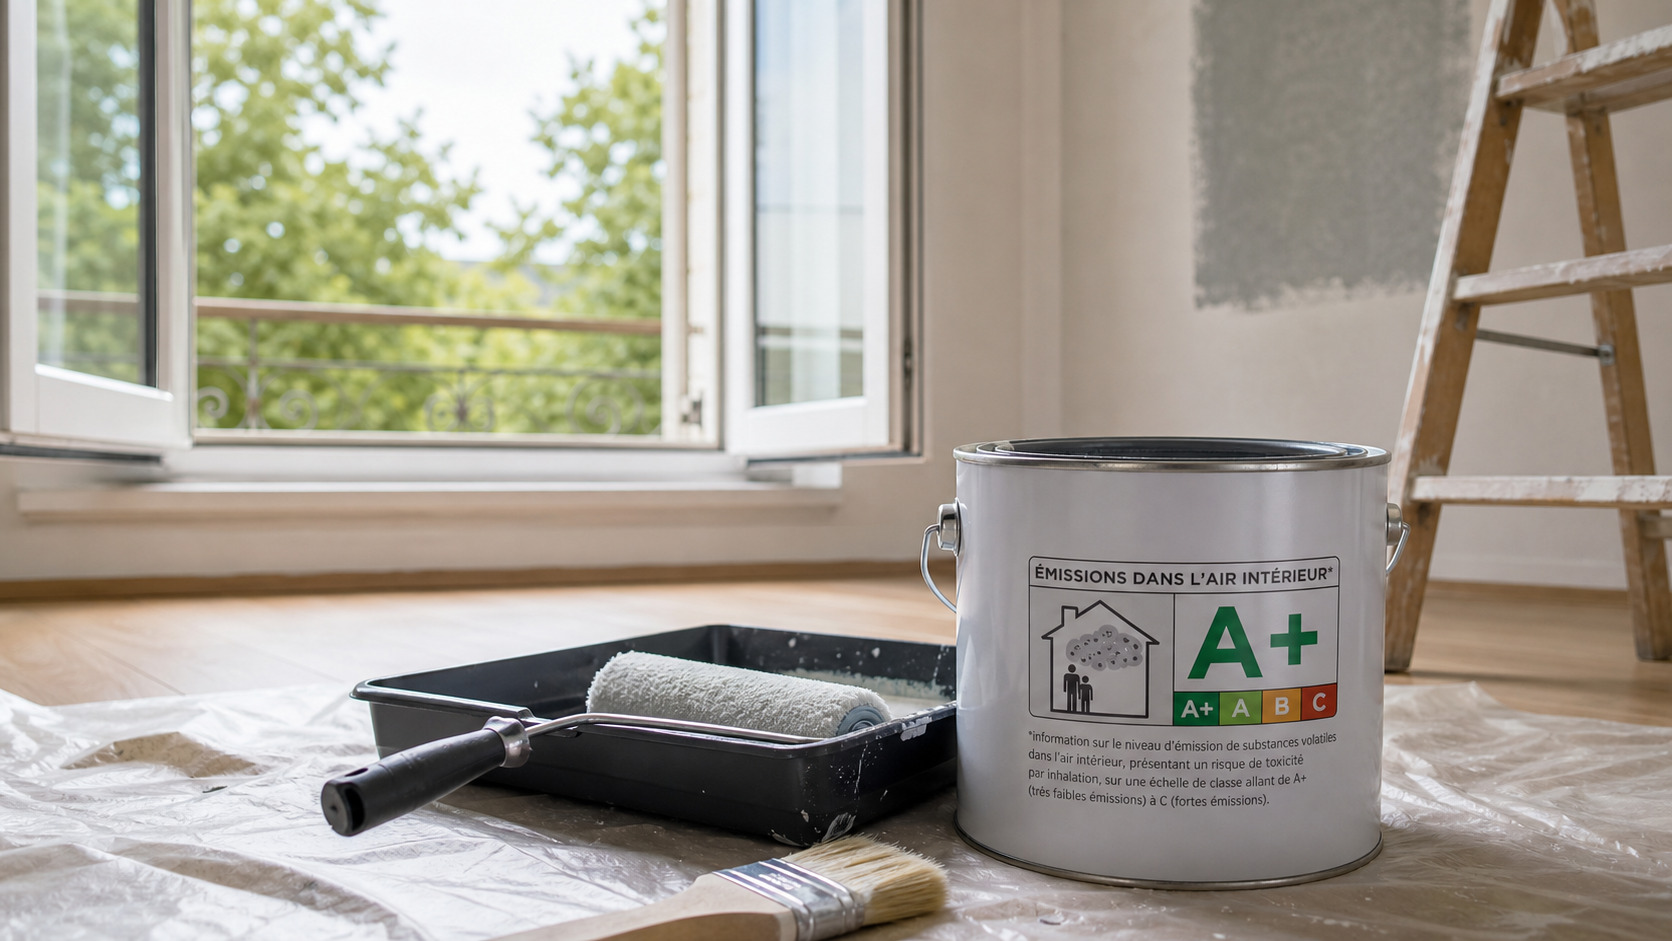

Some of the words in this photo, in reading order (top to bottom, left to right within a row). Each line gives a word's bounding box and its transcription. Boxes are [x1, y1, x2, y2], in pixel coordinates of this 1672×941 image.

[1035, 564, 1127, 584] ÉMISSIONS
[1132, 571, 1184, 586] DANS
[1191, 571, 1237, 586] L’AIR
[1187, 606, 1318, 679] A+
[1181, 699, 1213, 718] A+
[1231, 699, 1251, 718] A
[1275, 696, 1290, 716] B
[1311, 692, 1327, 712] C
[1093, 737, 1109, 749] sur
[1112, 737, 1122, 750] le
[1125, 739, 1161, 751] niveau
[1164, 740, 1223, 752] d'émission
[1226, 740, 1239, 752] de
[1242, 738, 1299, 751] substances
[1301, 732, 1337, 746] volatiles
[1028, 749, 1052, 760] dans
[1055, 752, 1073, 765] l'air
[1076, 753, 1126, 770] intérieur,
[1129, 757, 1190, 771] présentant
[1194, 759, 1207, 770] un
[1211, 757, 1245, 773] risque
[1249, 757, 1262, 769] de
[1265, 754, 1304, 768] toxicité
[1028, 769, 1044, 781] par
[1047, 770, 1102, 787] inhalation,
[1105, 777, 1122, 787] sur
[1125, 777, 1147, 788] une
[1149, 776, 1189, 788] échelle
[1193, 777, 1206, 788] de
[1210, 777, 1242, 788] classe
[1245, 775, 1274, 787] allant
[1277, 774, 1290, 786] de
[1293, 773, 1307, 784] A+
[1053, 788, 1087, 801] faibles
[1089, 791, 1147, 806] émissions)
[1149, 794, 1157, 806] à
[1159, 795, 1168, 806] C
[1171, 794, 1207, 808] (fortes
[1210, 793, 1269, 806] émissions).
